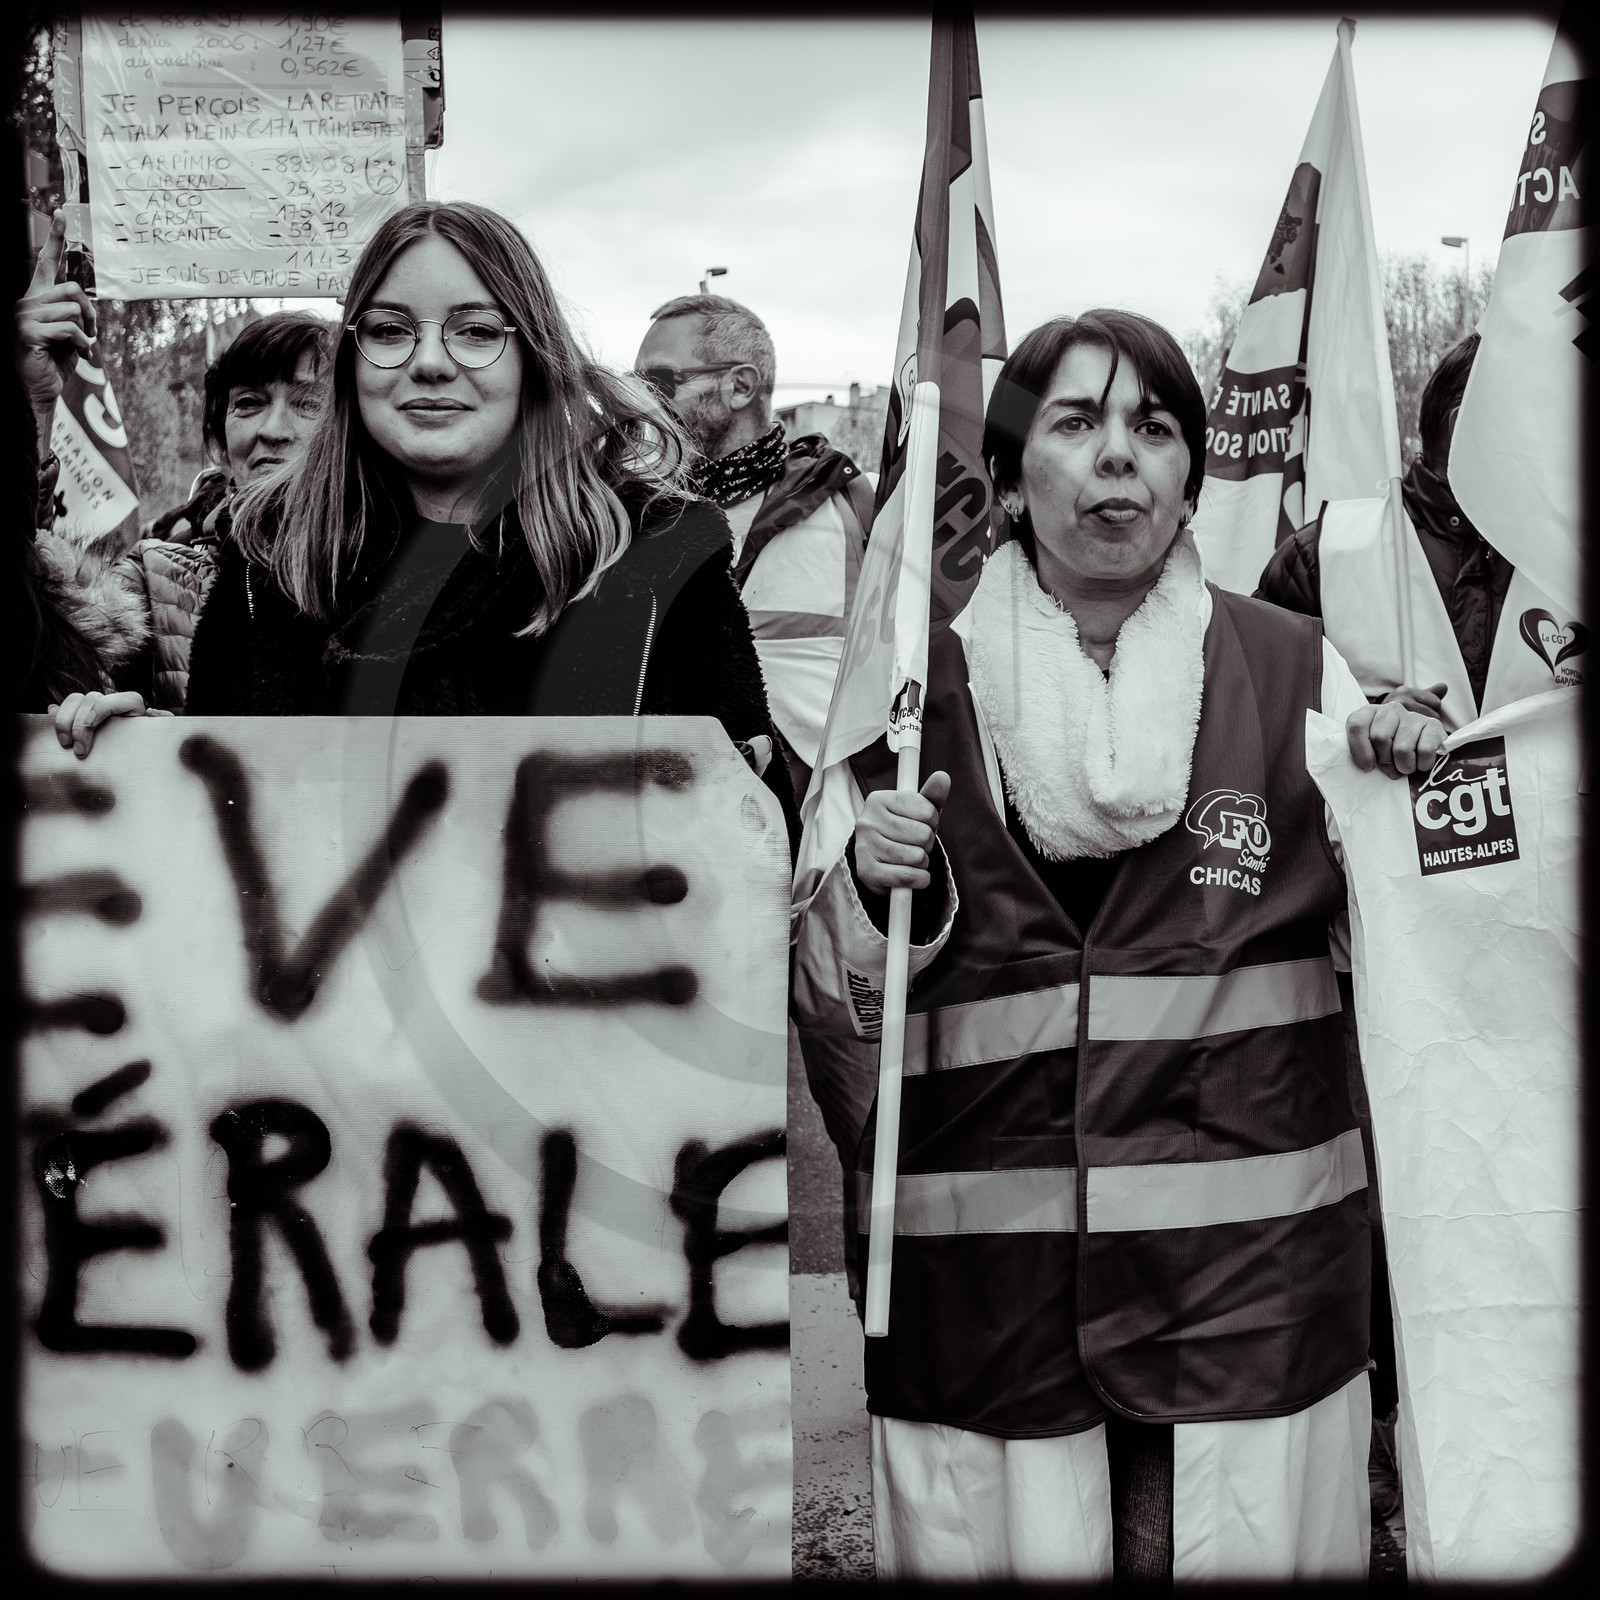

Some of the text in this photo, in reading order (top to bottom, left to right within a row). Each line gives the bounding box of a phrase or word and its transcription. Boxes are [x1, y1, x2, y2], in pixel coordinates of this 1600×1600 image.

[274, 11, 350, 36] 1,90€
[117, 31, 172, 56] depuis
[195, 34, 246, 51] 2006
[278, 34, 349, 55] 1,27€
[280, 56, 364, 79] 0,562€
[101, 94, 138, 115] JE
[120, 123, 170, 143] TAUX
[286, 178, 349, 202] 25,33
[135, 210, 213, 227] CARSAT
[274, 200, 357, 226] 175,12
[133, 225, 233, 246] IRCANTEC
[288, 219, 351, 243] 59,79
[285, 247, 353, 269] 1143
[217, 268, 301, 288] DEVENUE
[1551, 634, 1568, 646] CGT
[1415, 767, 1511, 836] cgt
[1219, 810, 1272, 857] FO
[1238, 848, 1271, 874] Santé
[1423, 837, 1515, 868] HAUTES-ALPES
[1189, 865, 1262, 897] CHICAS
[34, 1057, 791, 1373] ÉRALE
